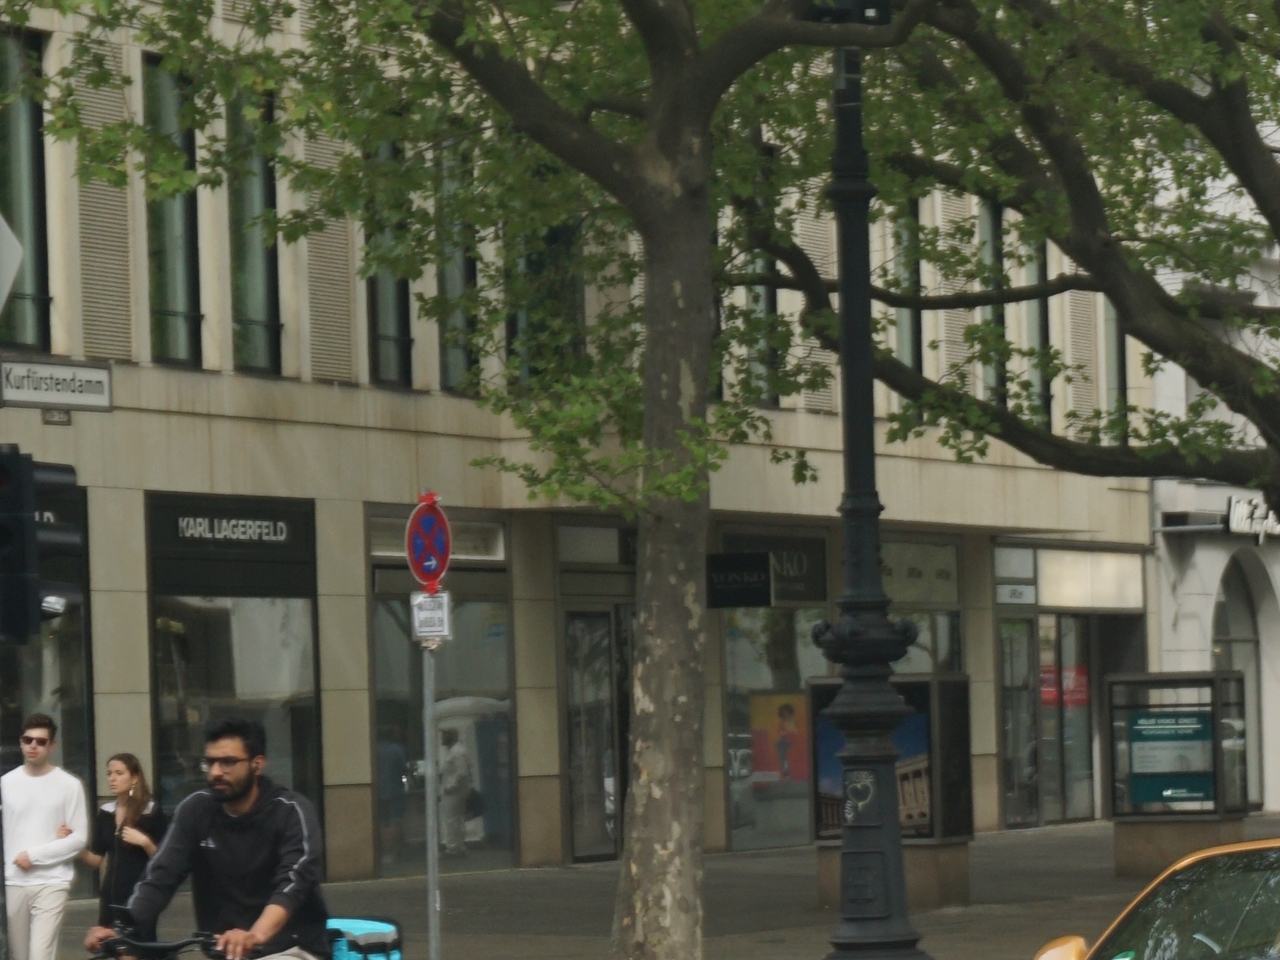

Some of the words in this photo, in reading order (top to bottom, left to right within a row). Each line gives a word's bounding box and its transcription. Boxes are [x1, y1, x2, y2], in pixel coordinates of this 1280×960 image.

[4, 366, 104, 395] Kurfürstendamm
[178, 516, 213, 538] KARL
[214, 518, 287, 541] LAGERFELD
